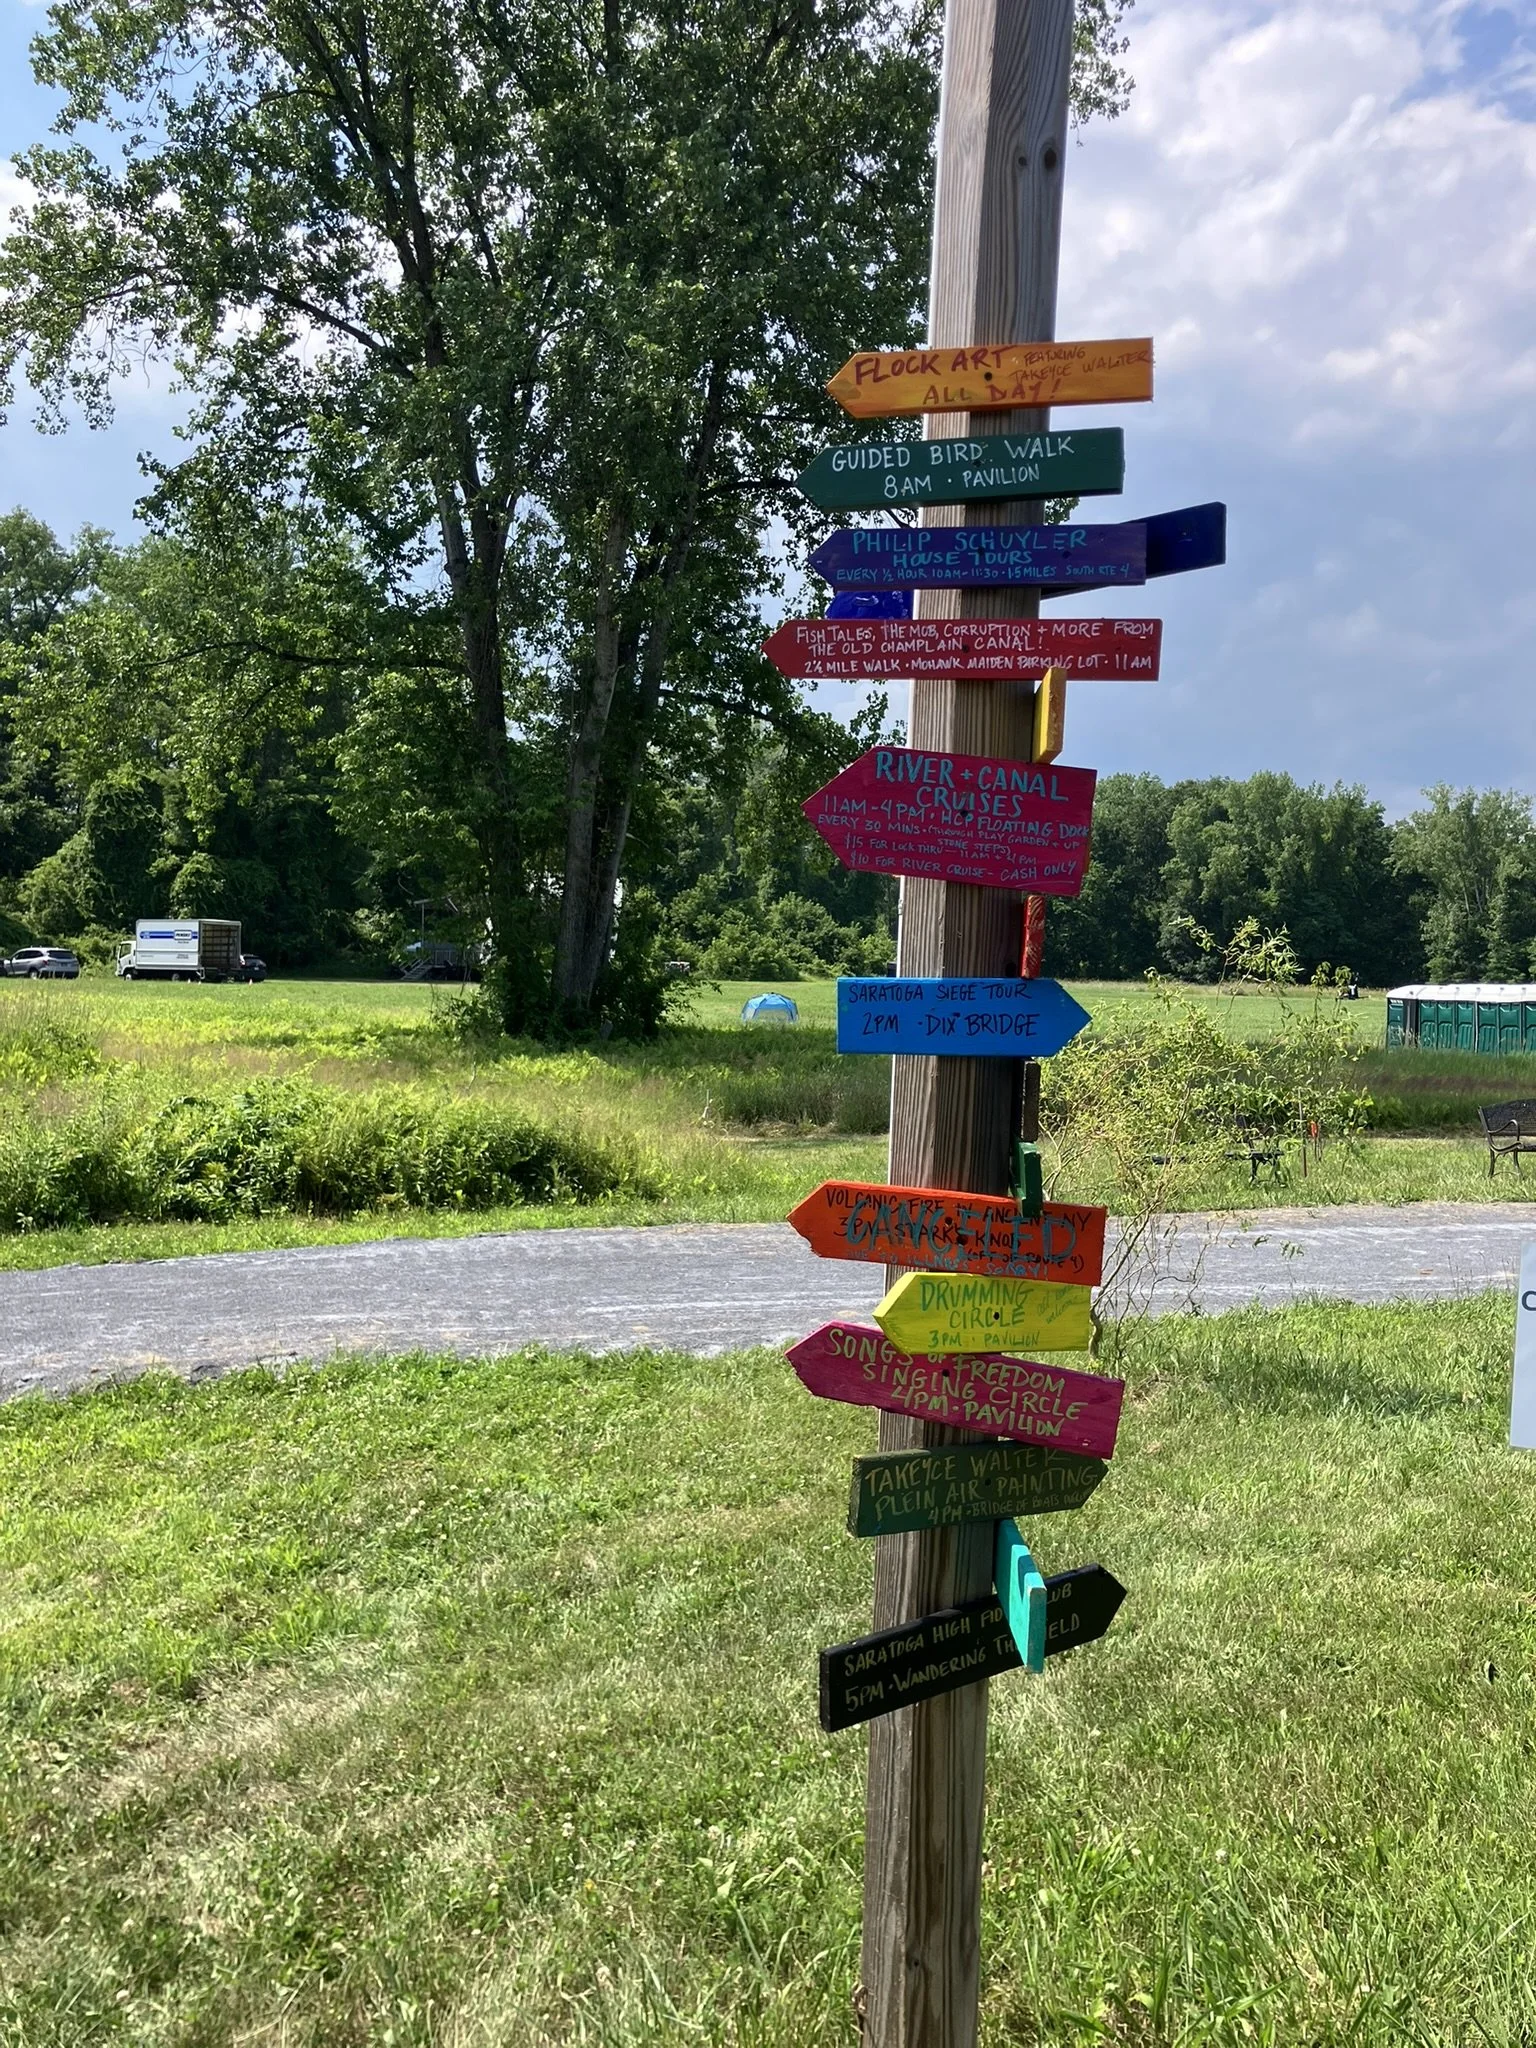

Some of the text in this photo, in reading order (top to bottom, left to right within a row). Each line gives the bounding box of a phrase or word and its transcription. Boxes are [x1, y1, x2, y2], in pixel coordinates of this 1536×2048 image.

[855, 346, 1017, 386] FLOCK ART
[1024, 347, 1086, 367] FEATURING
[1083, 351, 1152, 374] WALTER
[923, 379, 1062, 405] ALL DAY!
[832, 436, 1075, 472] GUIDED BIRD WALK
[884, 464, 1040, 500] 8AM PAVILION
[853, 529, 1087, 555] PHILIP SCHUYLER
[893, 550, 1032, 568] HOUSE TOURS
[836, 568, 878, 583] EVERY
[897, 568, 927, 580] HOUR
[1066, 564, 1095, 576] SOUTH
[1119, 563, 1130, 578] 4
[796, 626, 826, 644] FISH
[880, 620, 906, 641] THE
[910, 624, 939, 640] MOB,
[943, 622, 1031, 638] CORRUPTION
[1052, 622, 1103, 638] MORE
[1114, 622, 1154, 636] FROM
[808, 635, 1043, 657] THE OLD CHAMPLAIN CANAL!
[826, 660, 859, 673] MILE
[863, 659, 901, 672] WALK
[911, 656, 964, 670] MOHAWK
[967, 655, 1014, 669] MAIDEN
[1017, 654, 1074, 669] PARKING
[1078, 654, 1106, 668] LOT
[1115, 654, 1152, 670] 11AM
[876, 751, 954, 788] RIVER
[978, 766, 1068, 801] CANAL
[917, 787, 1023, 818] CRUISES
[817, 814, 859, 830] EVERY
[865, 820, 881, 832] 30
[888, 822, 921, 835] MINS
[978, 831, 1006, 841] PLAY
[1008, 835, 1049, 847] GARDEN
[1063, 842, 1081, 850] UP
[977, 816, 1053, 838] FLOATING
[869, 838, 888, 849] FOR
[918, 844, 944, 855] THRU
[938, 838, 969, 850] STONE
[875, 856, 897, 867] FOR
[902, 858, 942, 872] RIVER
[1000, 866, 1038, 882] CASH
[1044, 860, 1077, 876] ONLY
[850, 981, 1032, 1003] SARATOGA SIEGE TOUR
[862, 1012, 1040, 1037] 2PM DIX BRIDGE
[826, 1188, 899, 1214] VOLCANIC
[921, 1280, 1034, 1312] DRUMMING
[950, 1304, 1026, 1329] CIRCLE
[928, 1330, 1040, 1348] 3PM PAVILION
[828, 1328, 914, 1366] SONGS
[953, 1353, 1065, 1397] FREEDOM
[863, 1363, 1089, 1421] SINGING CIRCLE
[891, 1386, 1065, 1438] 4PM PAVILION
[970, 1448, 1072, 1478] WALTER
[875, 1487, 937, 1522] PLEIN
[945, 1479, 981, 1505] AIR
[996, 1465, 1098, 1497] PAINTING
[927, 1505, 962, 1524] 4PM
[971, 1499, 1014, 1517] BRIDGE
[843, 1632, 924, 1677] SARATOGA
[933, 1617, 971, 1644] HIGH
[845, 1682, 885, 1713] 5PM
[892, 1646, 987, 1693] WANDERING
[992, 1633, 1015, 1656] TH
